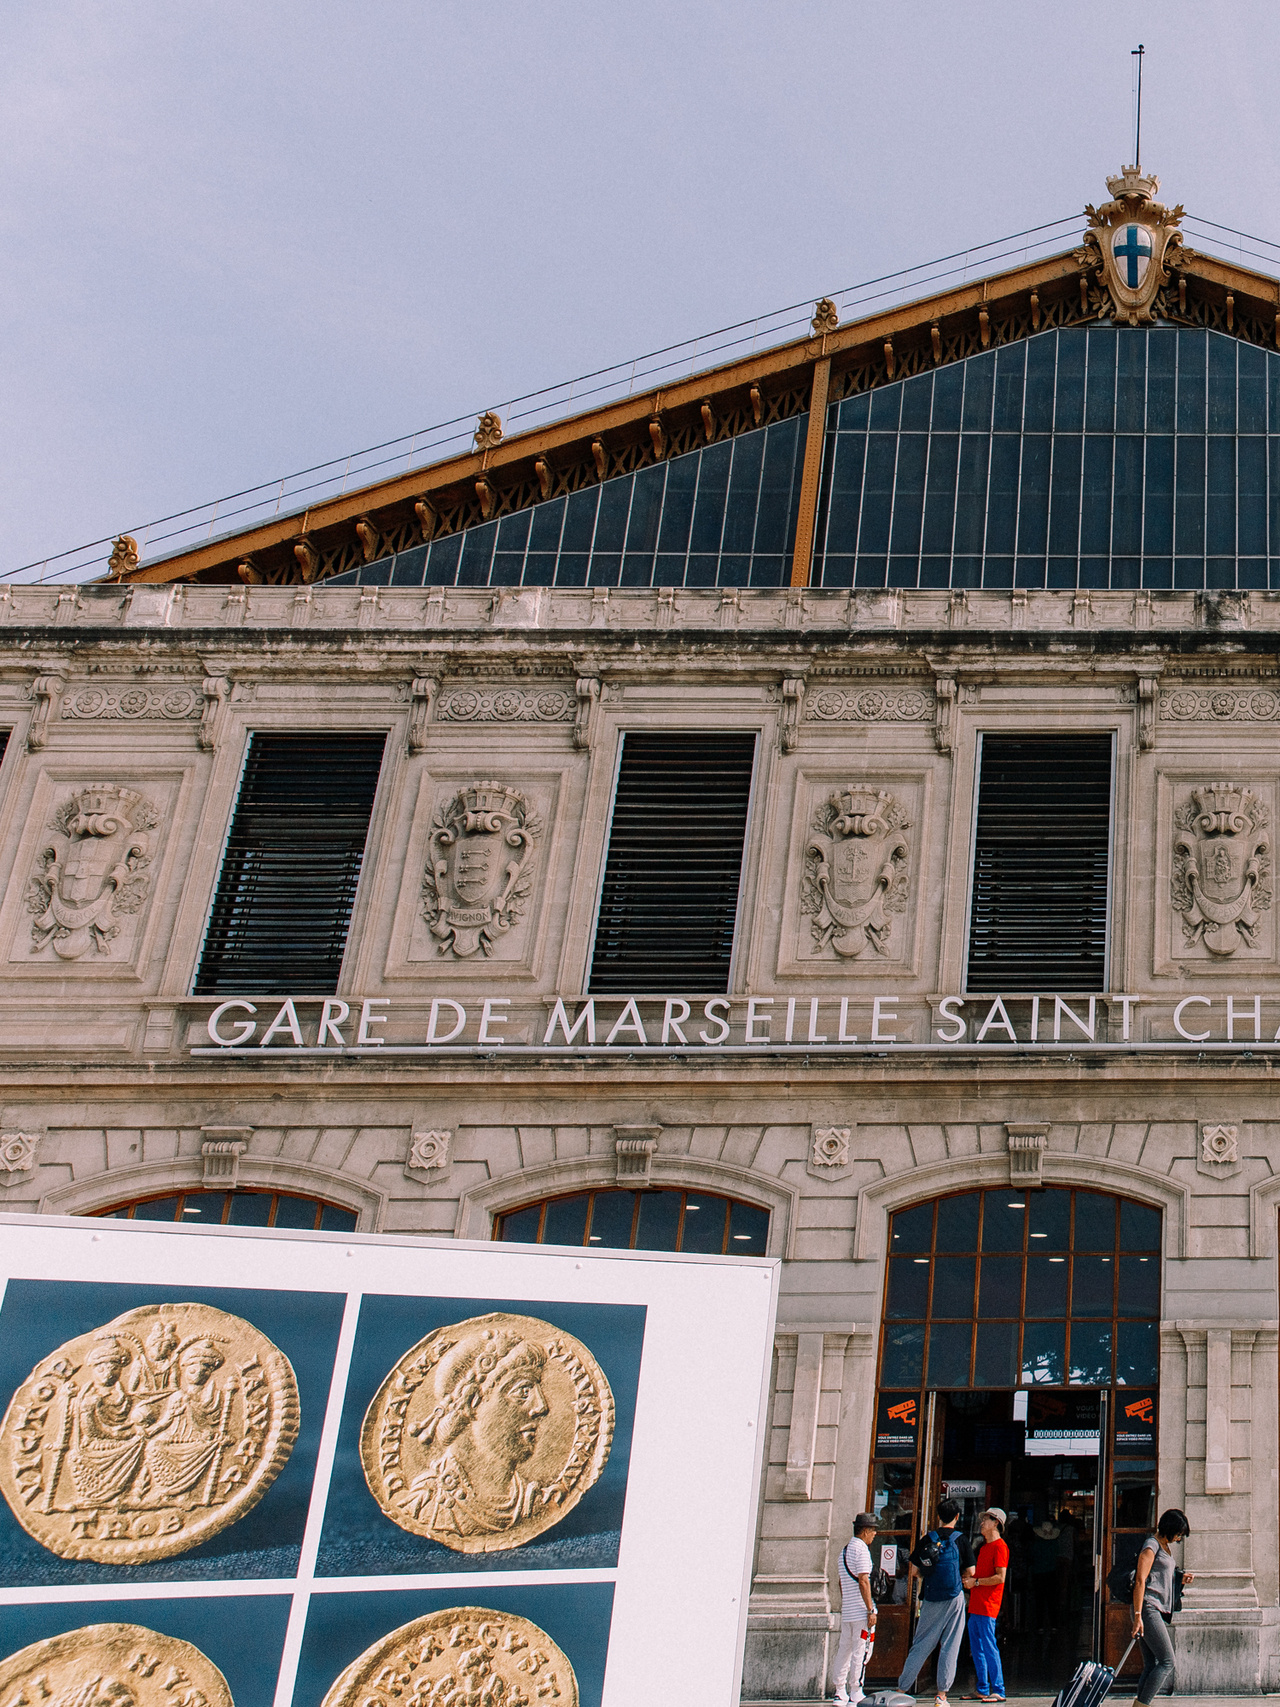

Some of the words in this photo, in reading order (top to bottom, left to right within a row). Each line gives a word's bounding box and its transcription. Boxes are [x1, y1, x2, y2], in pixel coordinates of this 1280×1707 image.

[207, 998, 391, 1047] GARE
[427, 998, 511, 1045] DE
[543, 996, 900, 1045] MARSEILLE
[937, 995, 1139, 1042] SAINT
[950, 1485, 977, 1493] selecta
